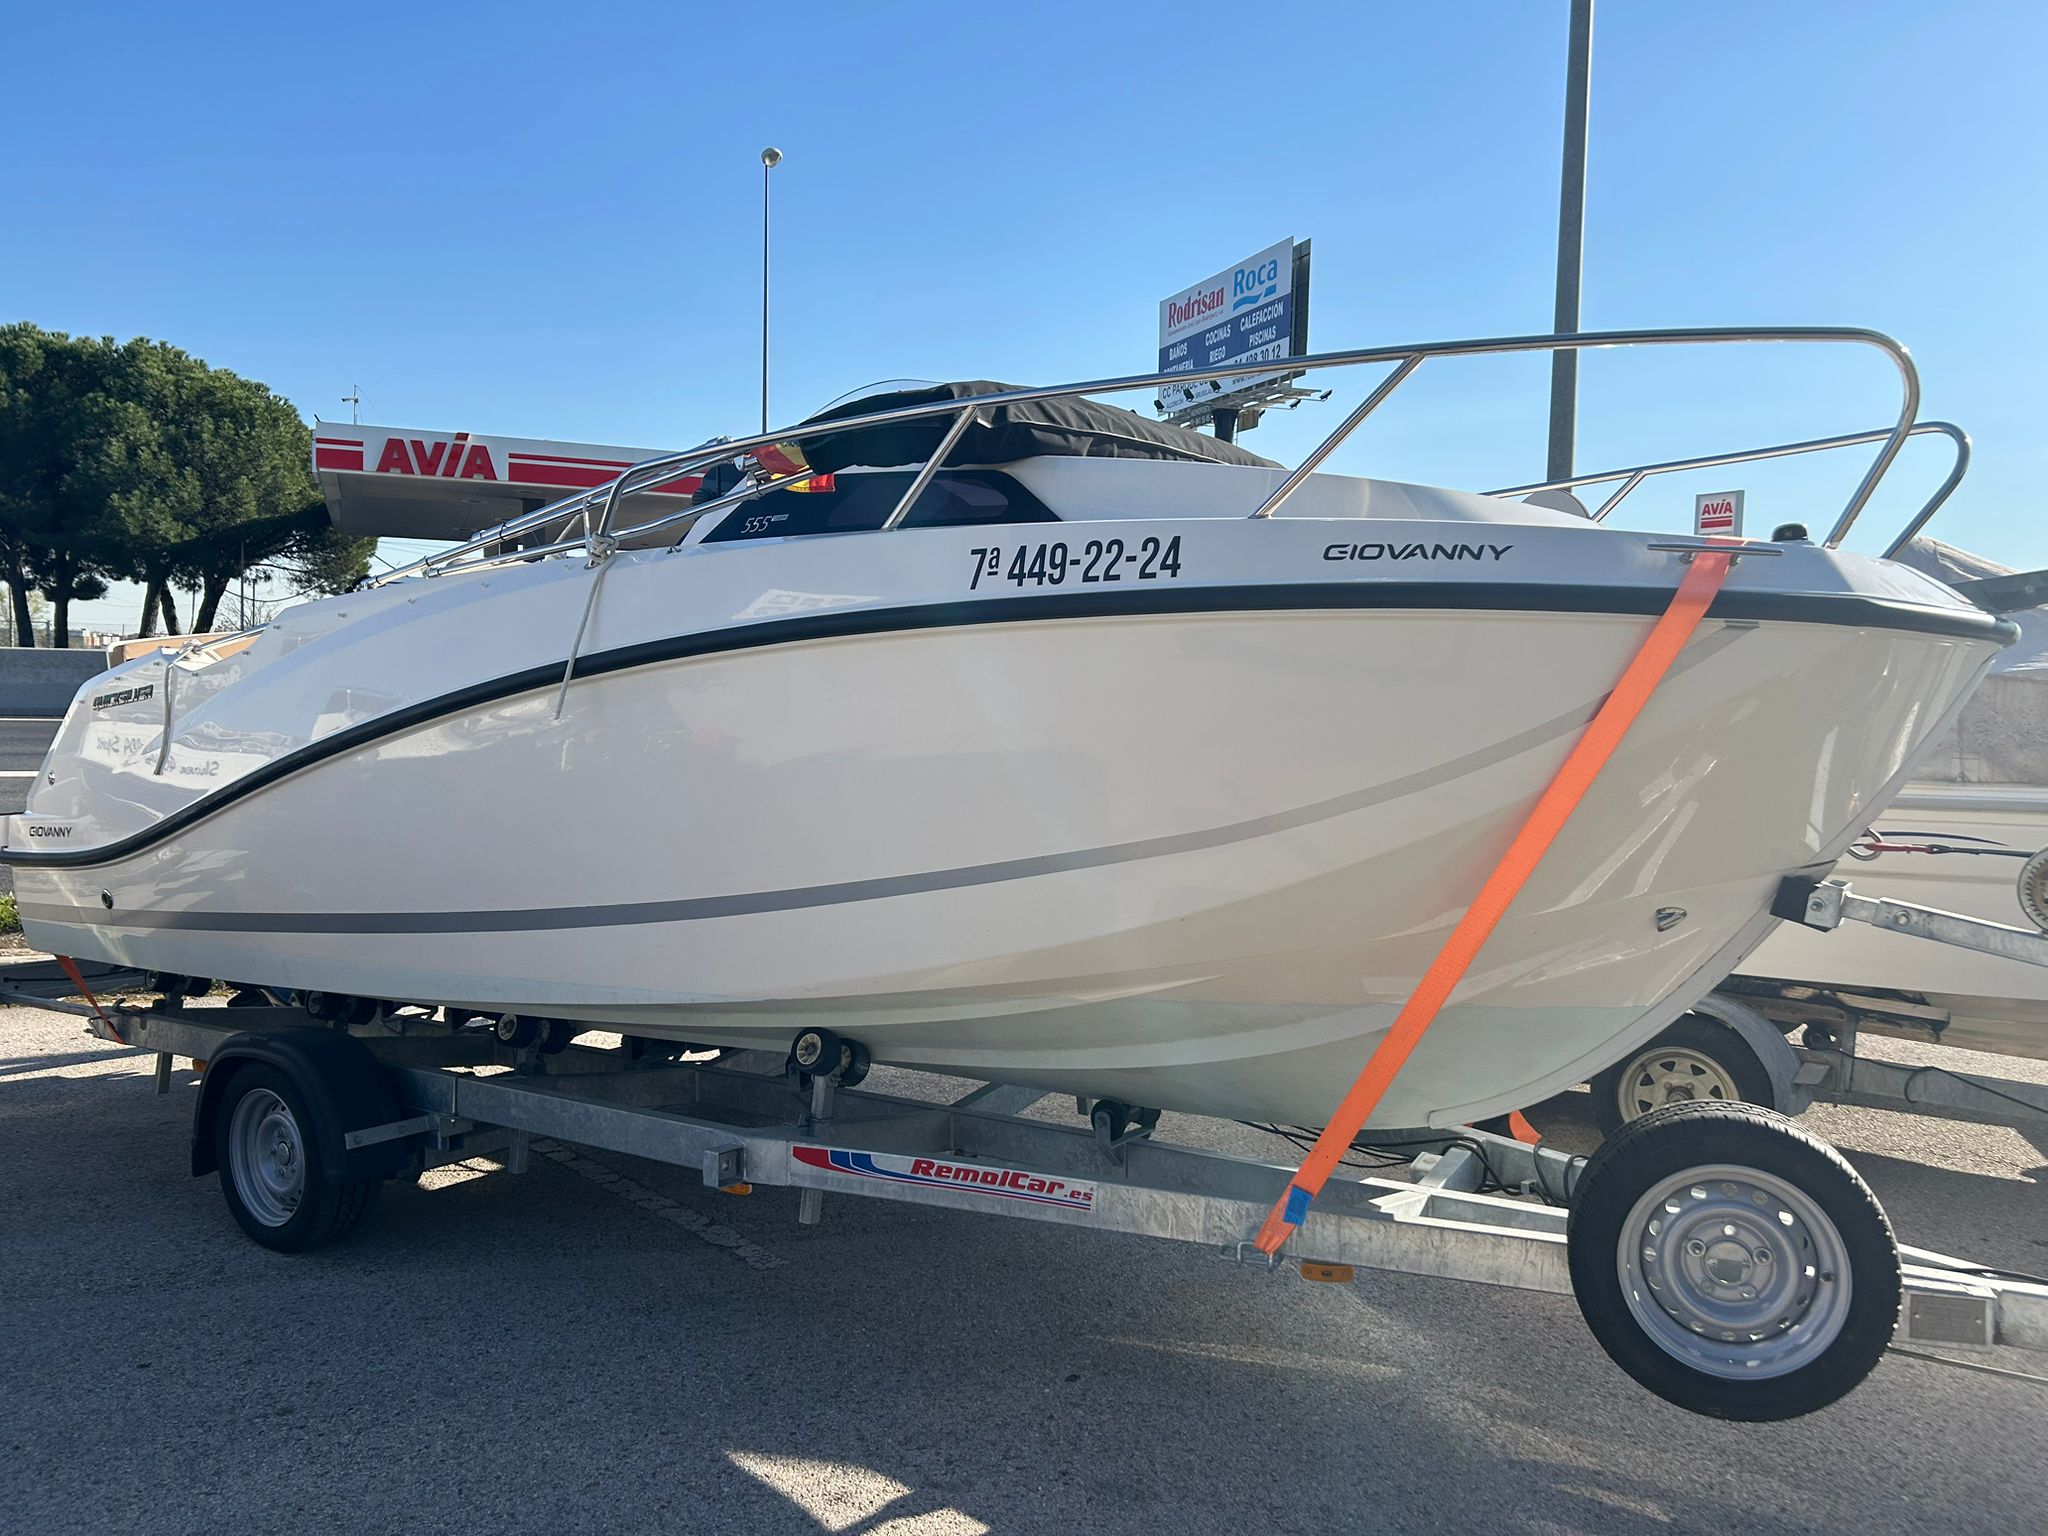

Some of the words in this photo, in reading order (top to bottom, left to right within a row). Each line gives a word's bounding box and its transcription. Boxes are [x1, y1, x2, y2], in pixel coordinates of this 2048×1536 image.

[1233, 258, 1278, 298] Roca
[1167, 286, 1225, 329] Rodrisan
[1239, 299, 1284, 332] CALEFACCIÓN
[1205, 323, 1231, 347] COCINAS
[1248, 325, 1277, 348] PISCINAS
[1169, 341, 1188, 361] BAÑOS
[1209, 346, 1226, 364] RIEGO
[1260, 348, 1269, 361] 30
[1271, 343, 1281, 359] 12
[1163, 357, 1195, 373] TANERÍA
[1162, 386, 1172, 400] CC
[376, 432, 497, 481] AVIA
[1701, 499, 1733, 516] AVIA
[740, 515, 772, 534] 555
[1323, 543, 1514, 561] GIOVANNY
[969, 547, 1000, 590] 7ª
[1007, 535, 1181, 587] 449-22-24
[29, 826, 72, 838] GIOVANNY
[910, 1158, 1094, 1202] RemolCar.es
